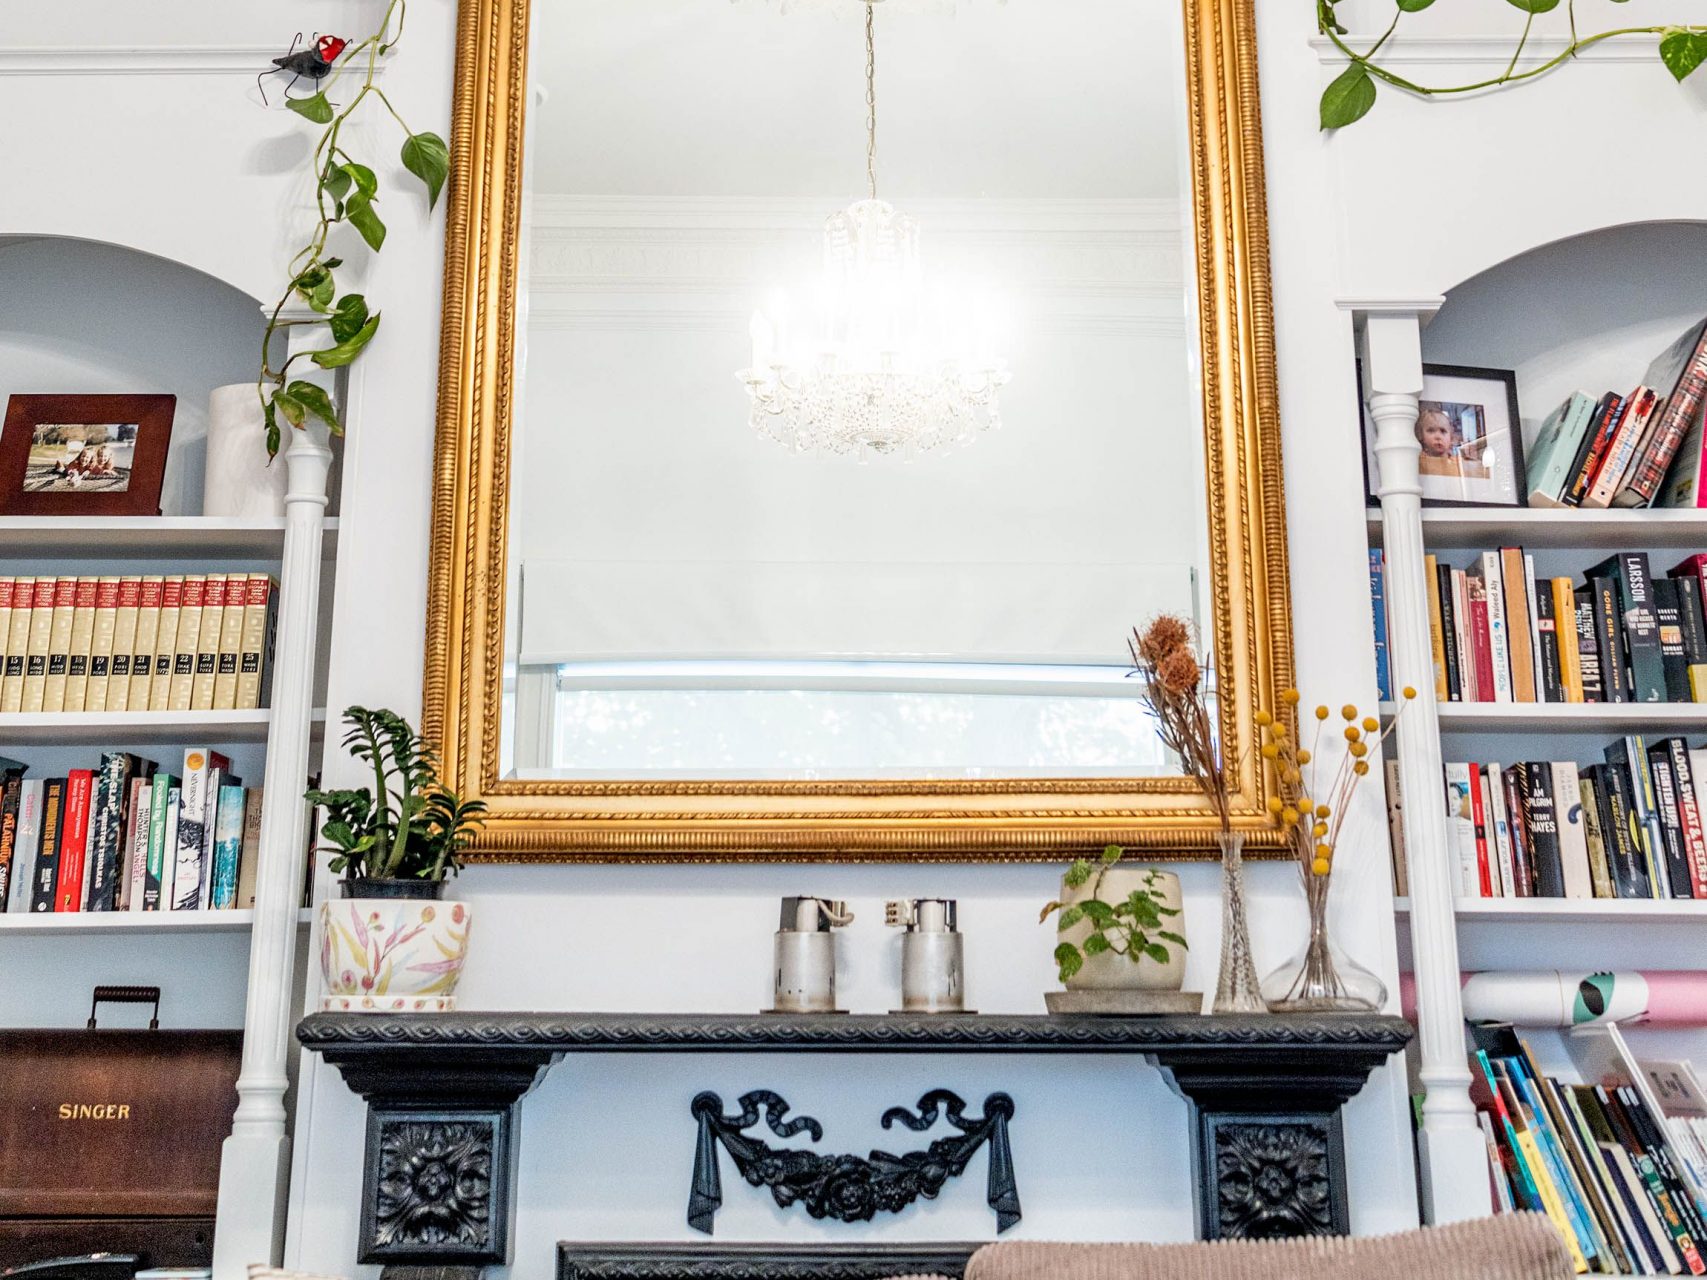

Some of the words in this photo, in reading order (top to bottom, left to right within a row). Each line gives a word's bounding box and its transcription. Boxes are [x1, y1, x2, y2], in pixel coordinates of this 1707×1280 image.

[1489, 579, 1499, 591] Aly
[1627, 557, 1646, 602] LARSSON
[1491, 592, 1500, 618] Waleed
[1603, 590, 1612, 614] GONE
[1580, 602, 1595, 640] MATTHEW
[1606, 618, 1614, 638] GIRL
[1582, 682, 1601, 693] 7
[109, 759, 119, 780] THE
[48, 783, 60, 797] THE
[107, 780, 117, 809] SLAP
[154, 779, 165, 808] Fooled
[1528, 797, 1552, 807] PILGRIM
[1533, 788, 1544, 797] AM
[44, 796, 58, 839] MONUMENTS
[72, 800, 83, 838] Anonymous
[99, 806, 109, 846] CHRISTOS
[141, 807, 150, 840] HUNTER
[151, 809, 162, 821] by
[1532, 821, 1556, 833] HAYES
[0, 812, 14, 864] PALAHNIUK
[134, 807, 144, 852] THOMPSON
[1688, 827, 1700, 840] &
[42, 839, 54, 856] MEN
[150, 821, 163, 875] Randomness
[1692, 839, 1707, 882] BEERS
[94, 847, 104, 888] TSIOLKAS
[58, 1103, 130, 1120] SINGER
